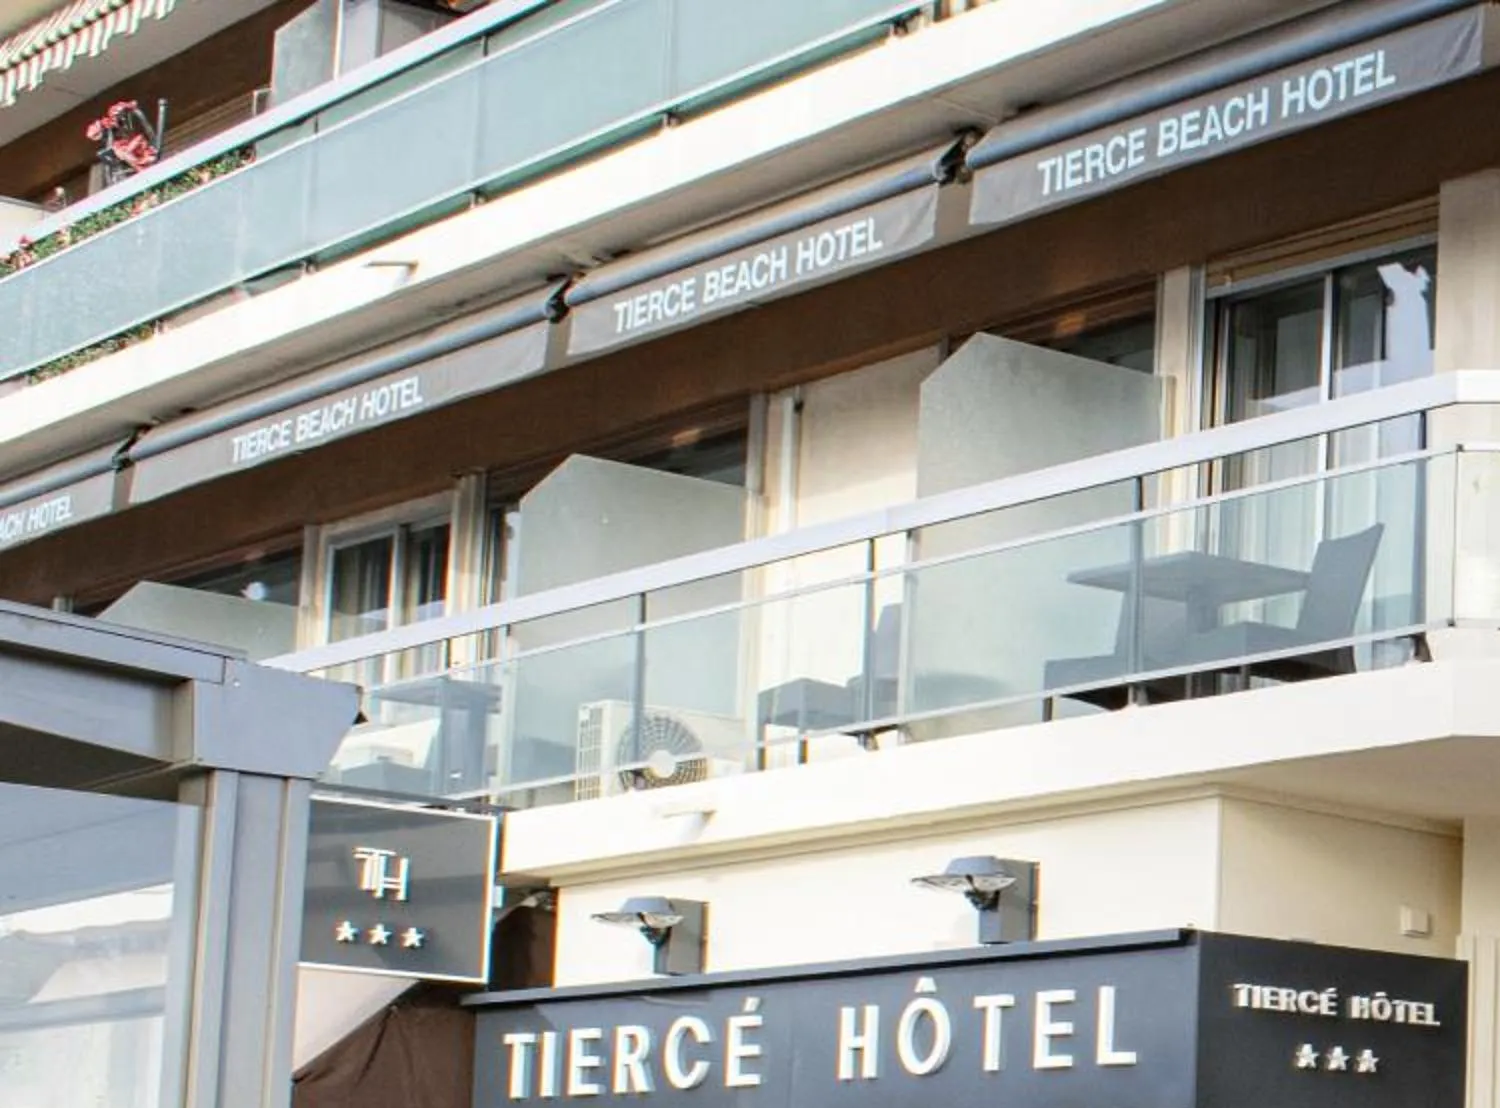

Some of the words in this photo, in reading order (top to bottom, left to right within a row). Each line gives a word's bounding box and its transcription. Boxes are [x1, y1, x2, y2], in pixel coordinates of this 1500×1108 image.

[1037, 127, 1148, 196] TIERCE
[1156, 87, 1270, 158] BEACH
[1280, 50, 1397, 118] HOTEL
[613, 277, 697, 334] TIERCE
[702, 245, 788, 304] BEACH
[795, 217, 884, 275] HOTEL
[232, 419, 292, 464] TIERCE
[295, 394, 358, 443] BEACH
[360, 375, 424, 421] HOTEL
[26, 494, 73, 533] HOTEL
[503, 996, 767, 1099] TIERCÉ
[836, 977, 1138, 1080] HÔTEL
[1232, 982, 1338, 1016] TIERCÉ
[1350, 991, 1441, 1027] HÔTEL
